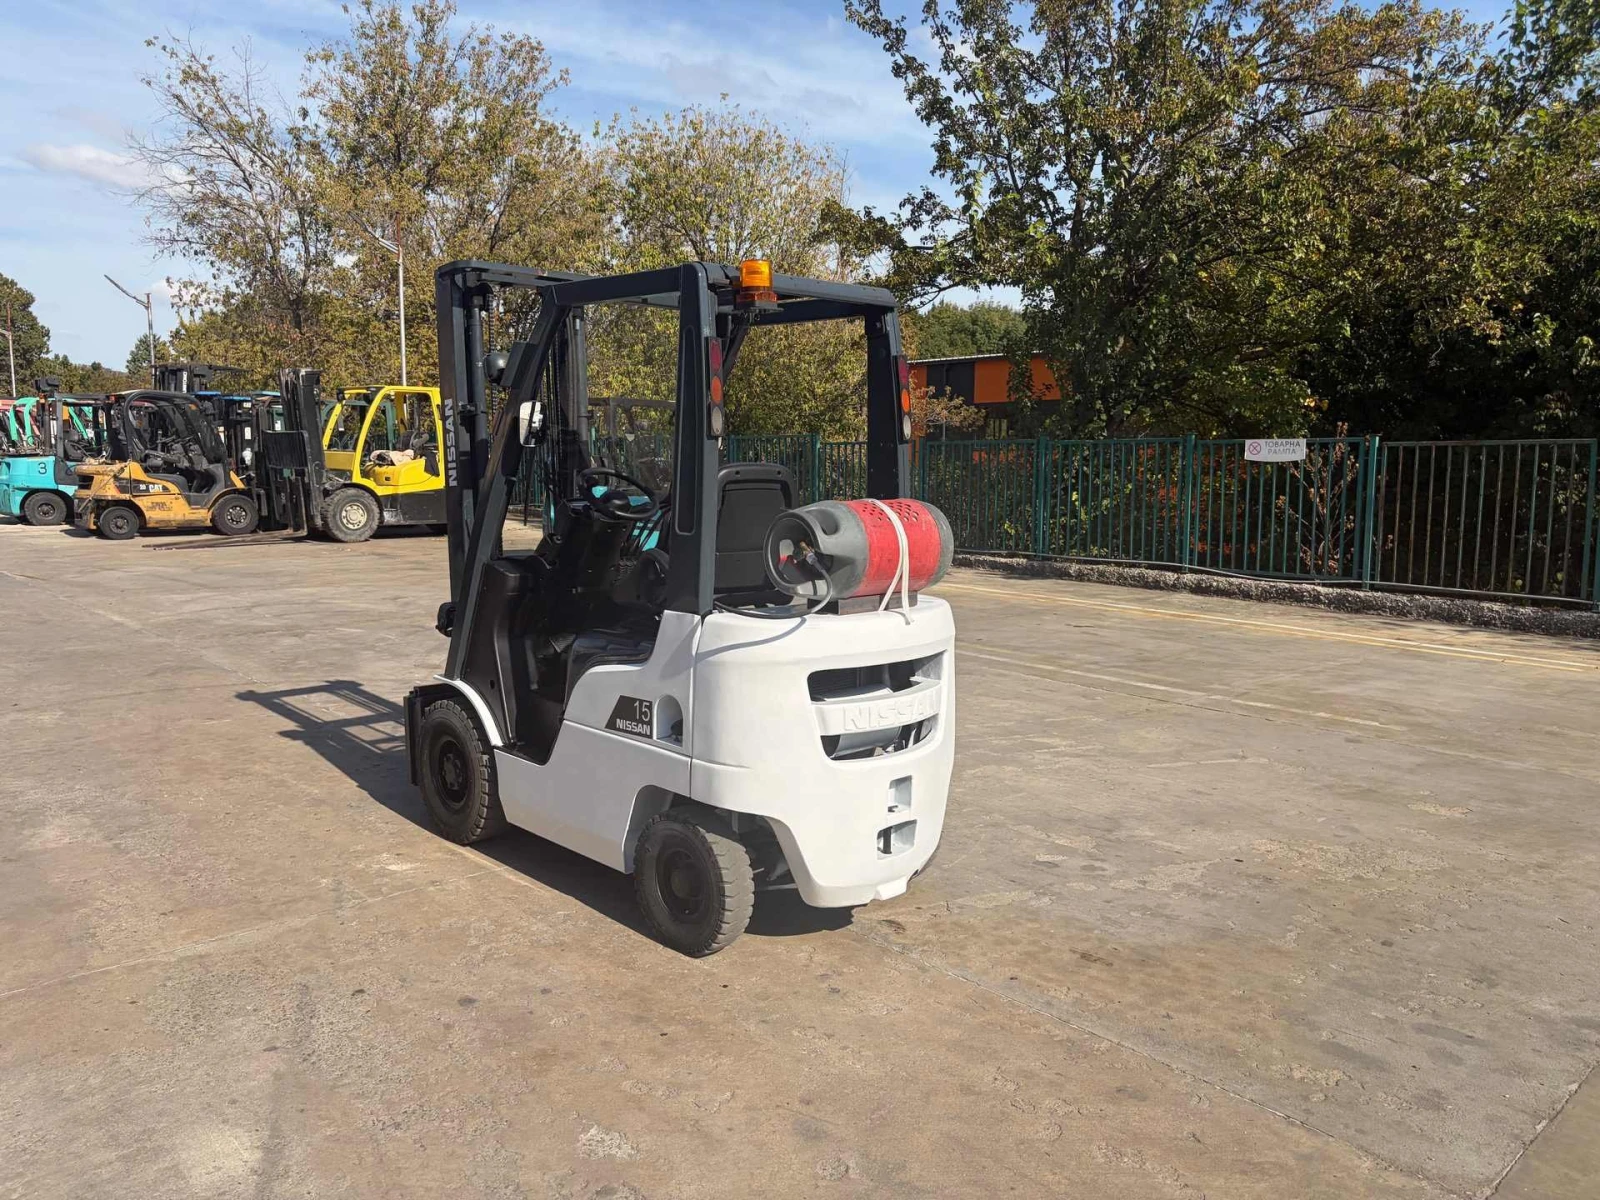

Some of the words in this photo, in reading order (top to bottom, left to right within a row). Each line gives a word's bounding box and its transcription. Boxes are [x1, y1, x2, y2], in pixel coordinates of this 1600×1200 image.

[444, 398, 458, 487] NISSAN
[38, 461, 48, 475] 3
[149, 483, 163, 493] CAT
[633, 700, 652, 722] 15
[843, 688, 938, 731] NISSAN
[616, 718, 651, 736] NISSAN
